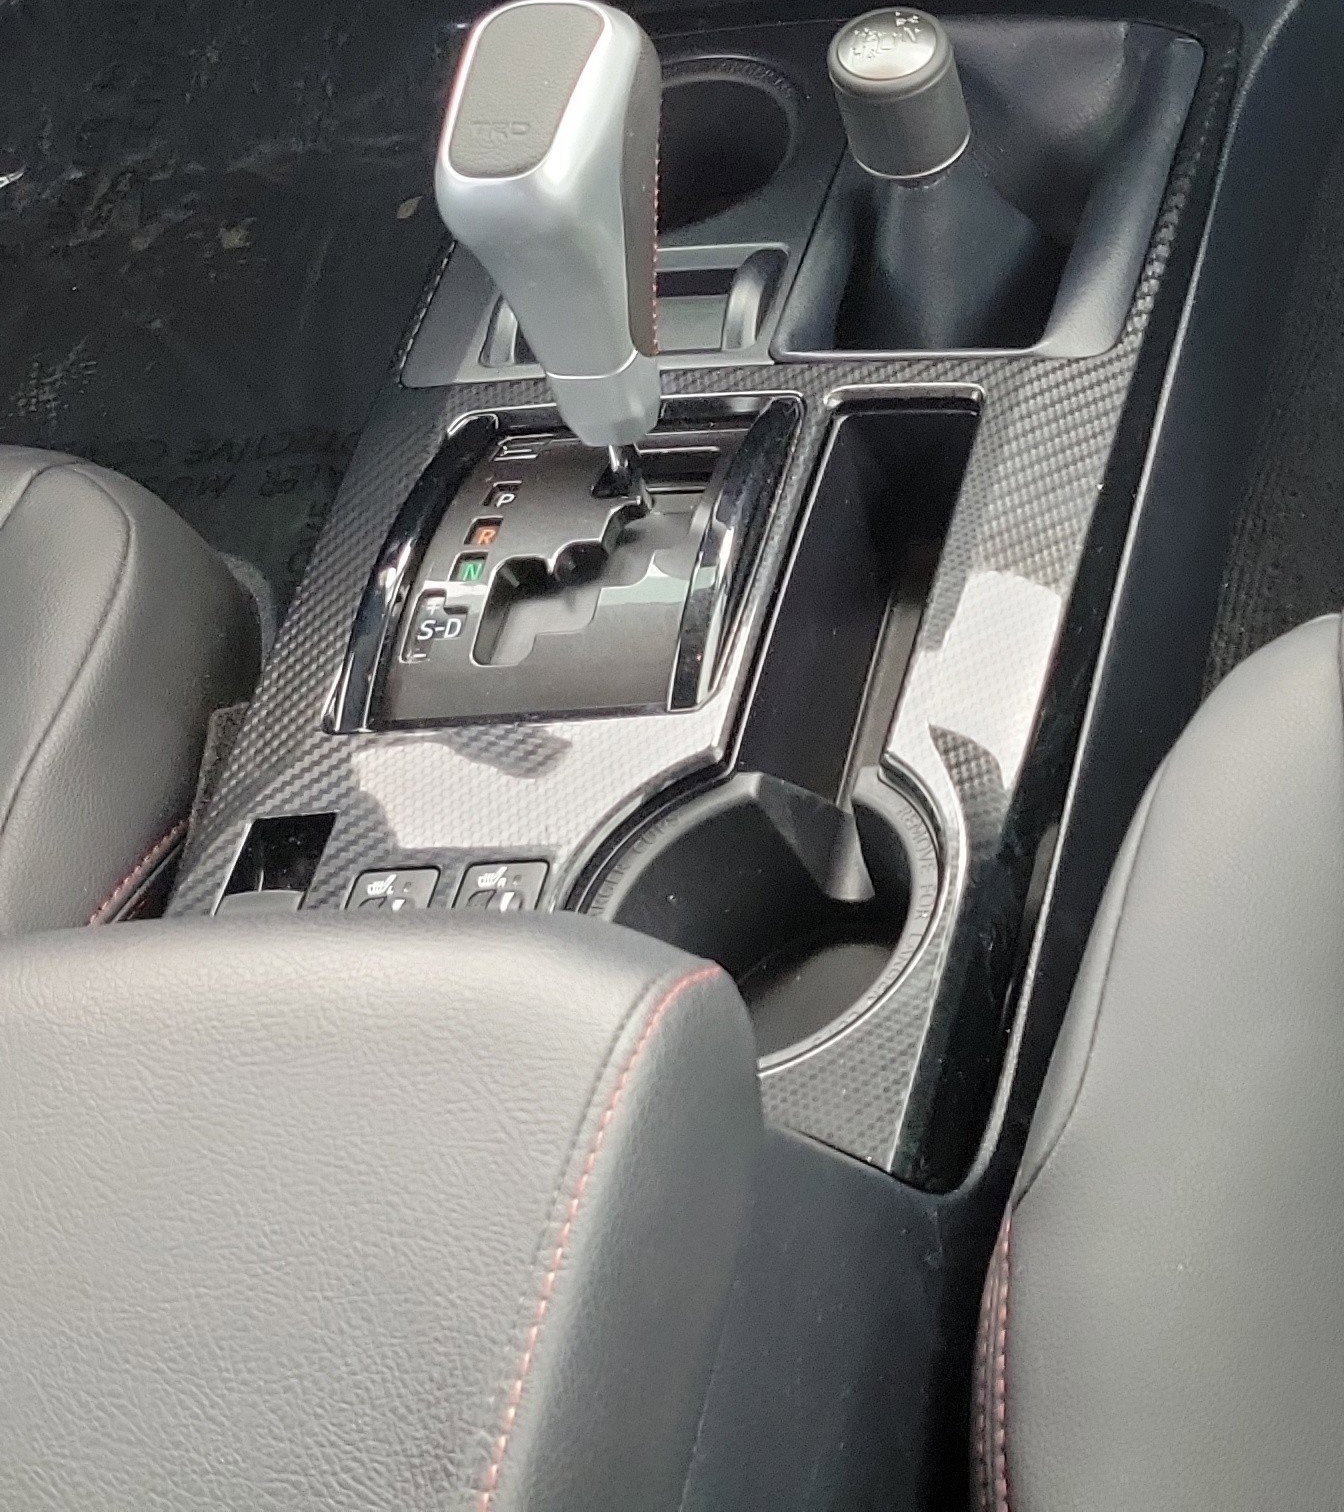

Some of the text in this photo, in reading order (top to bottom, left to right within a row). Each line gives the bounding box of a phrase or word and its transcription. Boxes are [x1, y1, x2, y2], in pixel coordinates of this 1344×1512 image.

[472, 120, 531, 139] TRD
[496, 492, 515, 507] P
[476, 528, 496, 545] R
[461, 563, 483, 580] N
